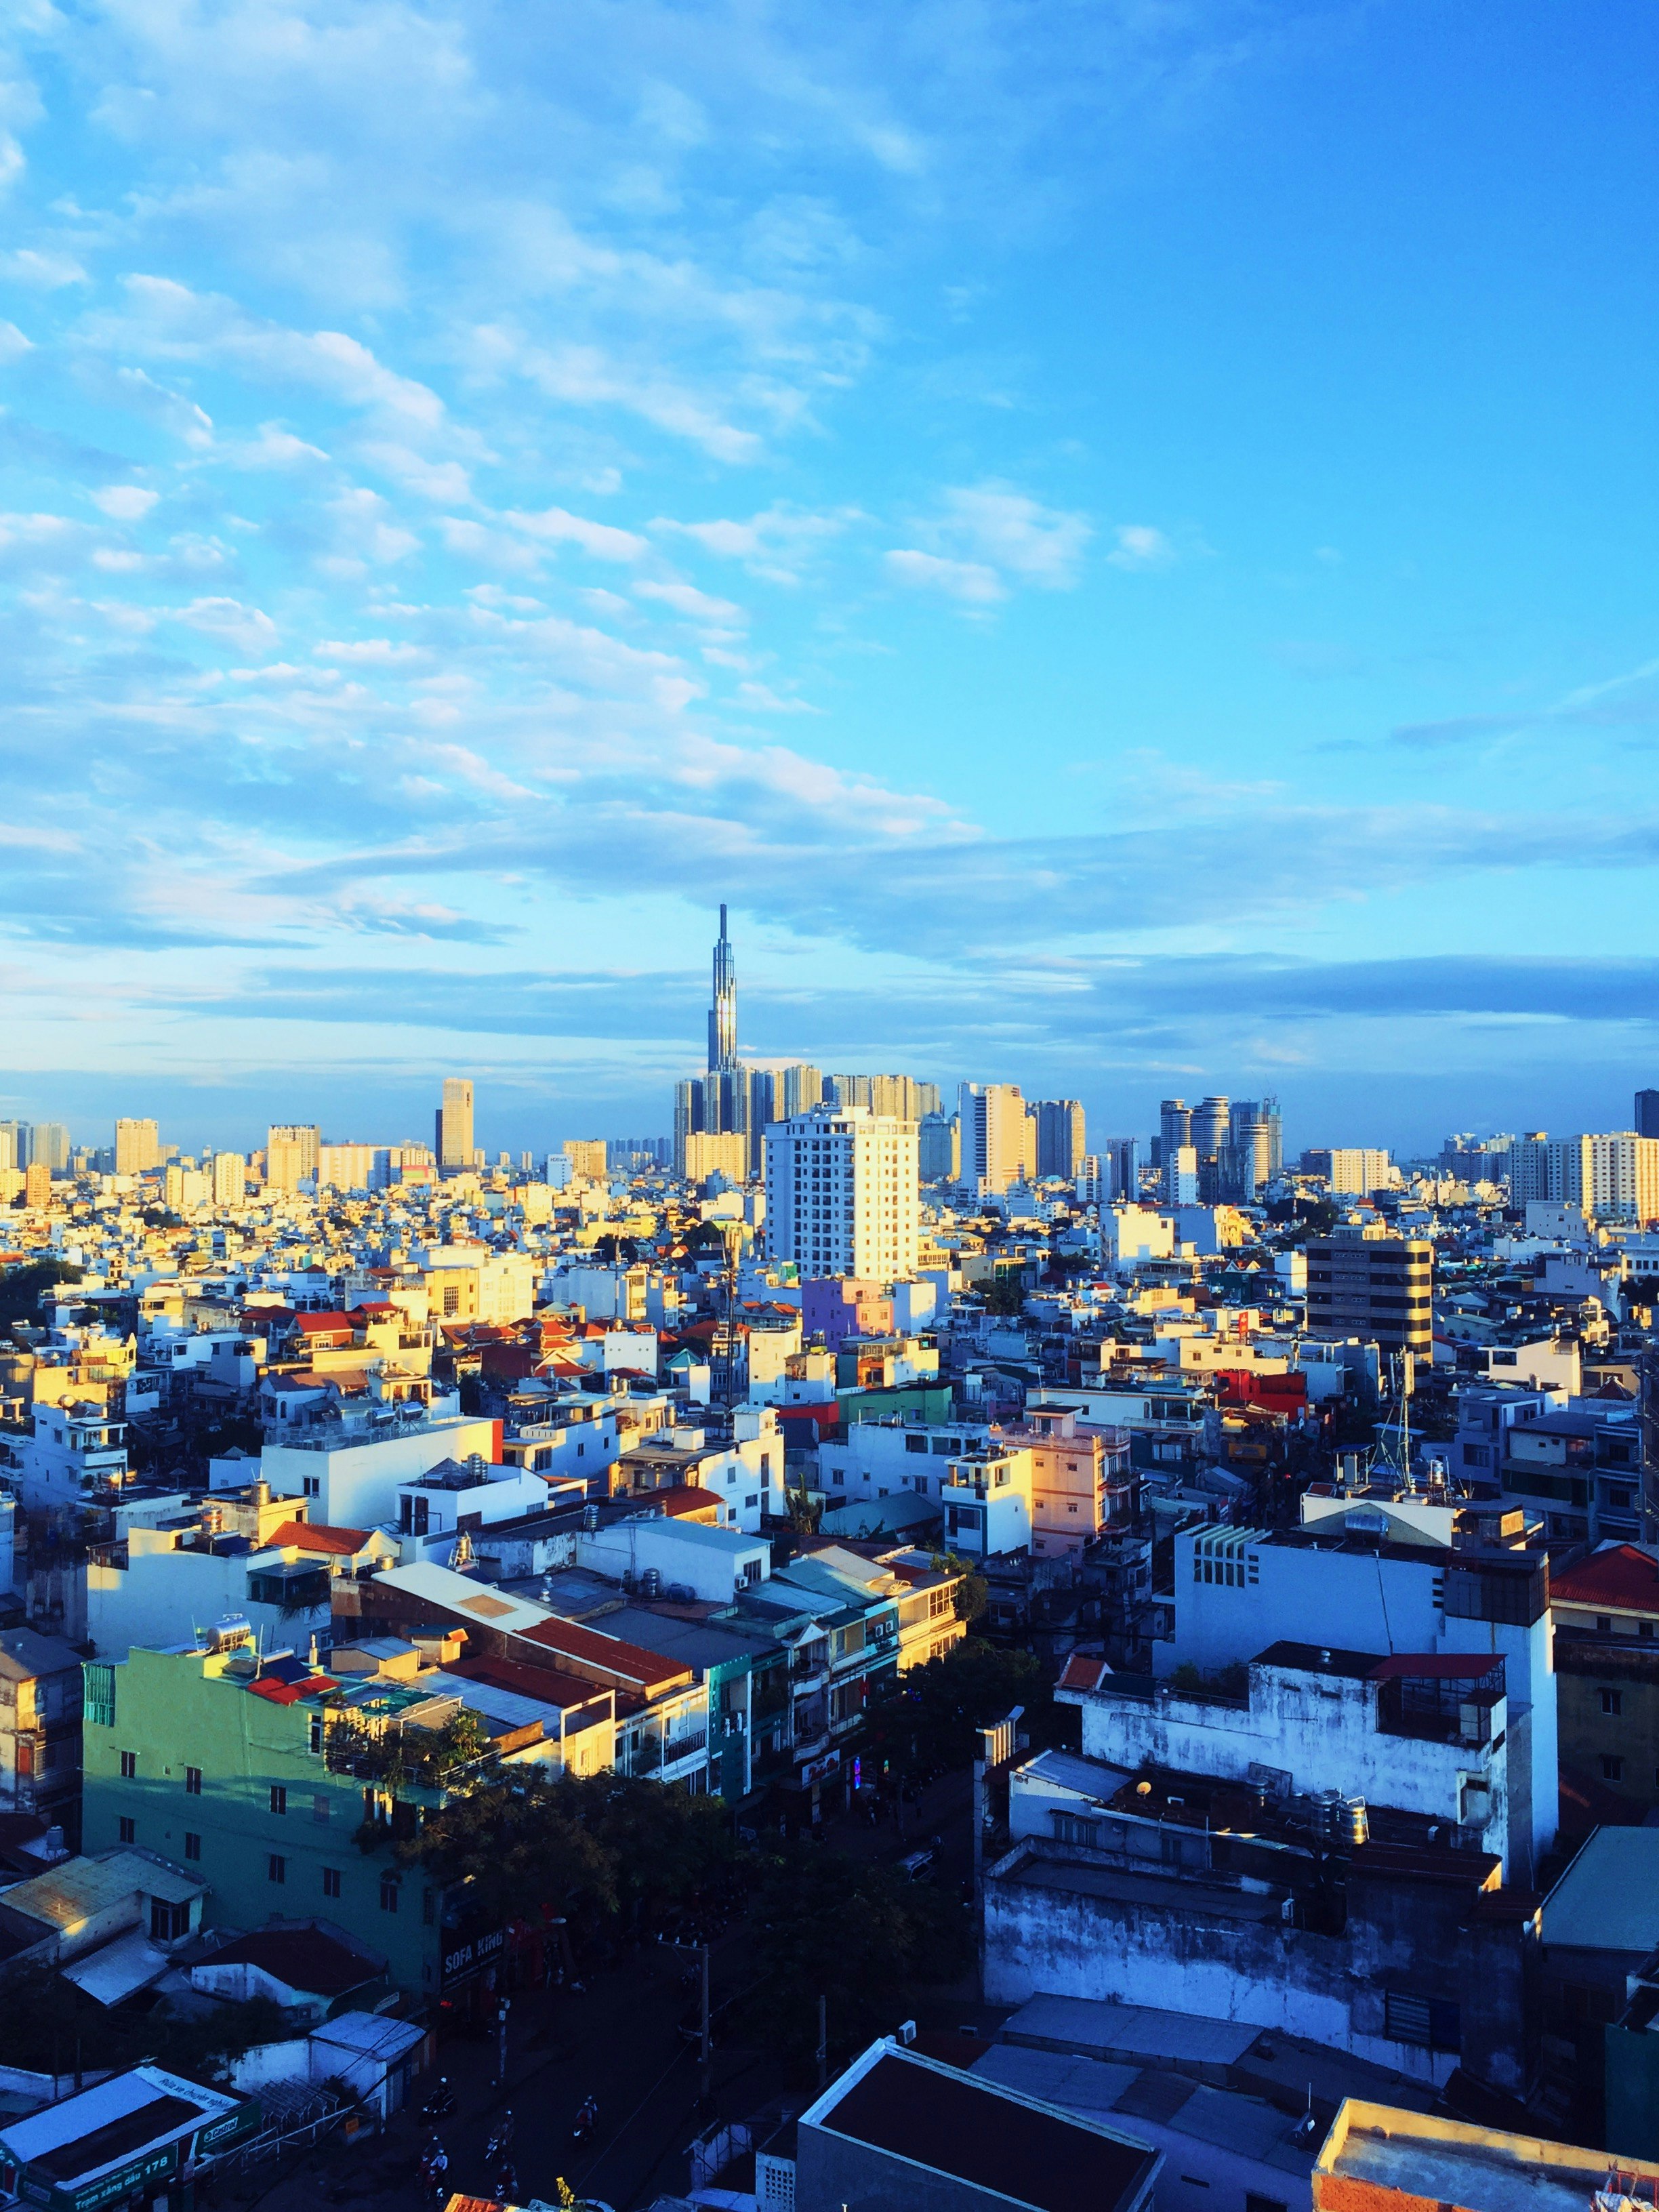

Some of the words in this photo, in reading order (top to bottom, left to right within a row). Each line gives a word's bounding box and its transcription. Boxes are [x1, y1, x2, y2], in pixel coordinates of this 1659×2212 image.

[445, 1944, 472, 1973] SOFA
[212, 2119, 237, 2138] Castrol
[101, 2182, 123, 2198] xăng
[144, 2156, 168, 2175] 178
